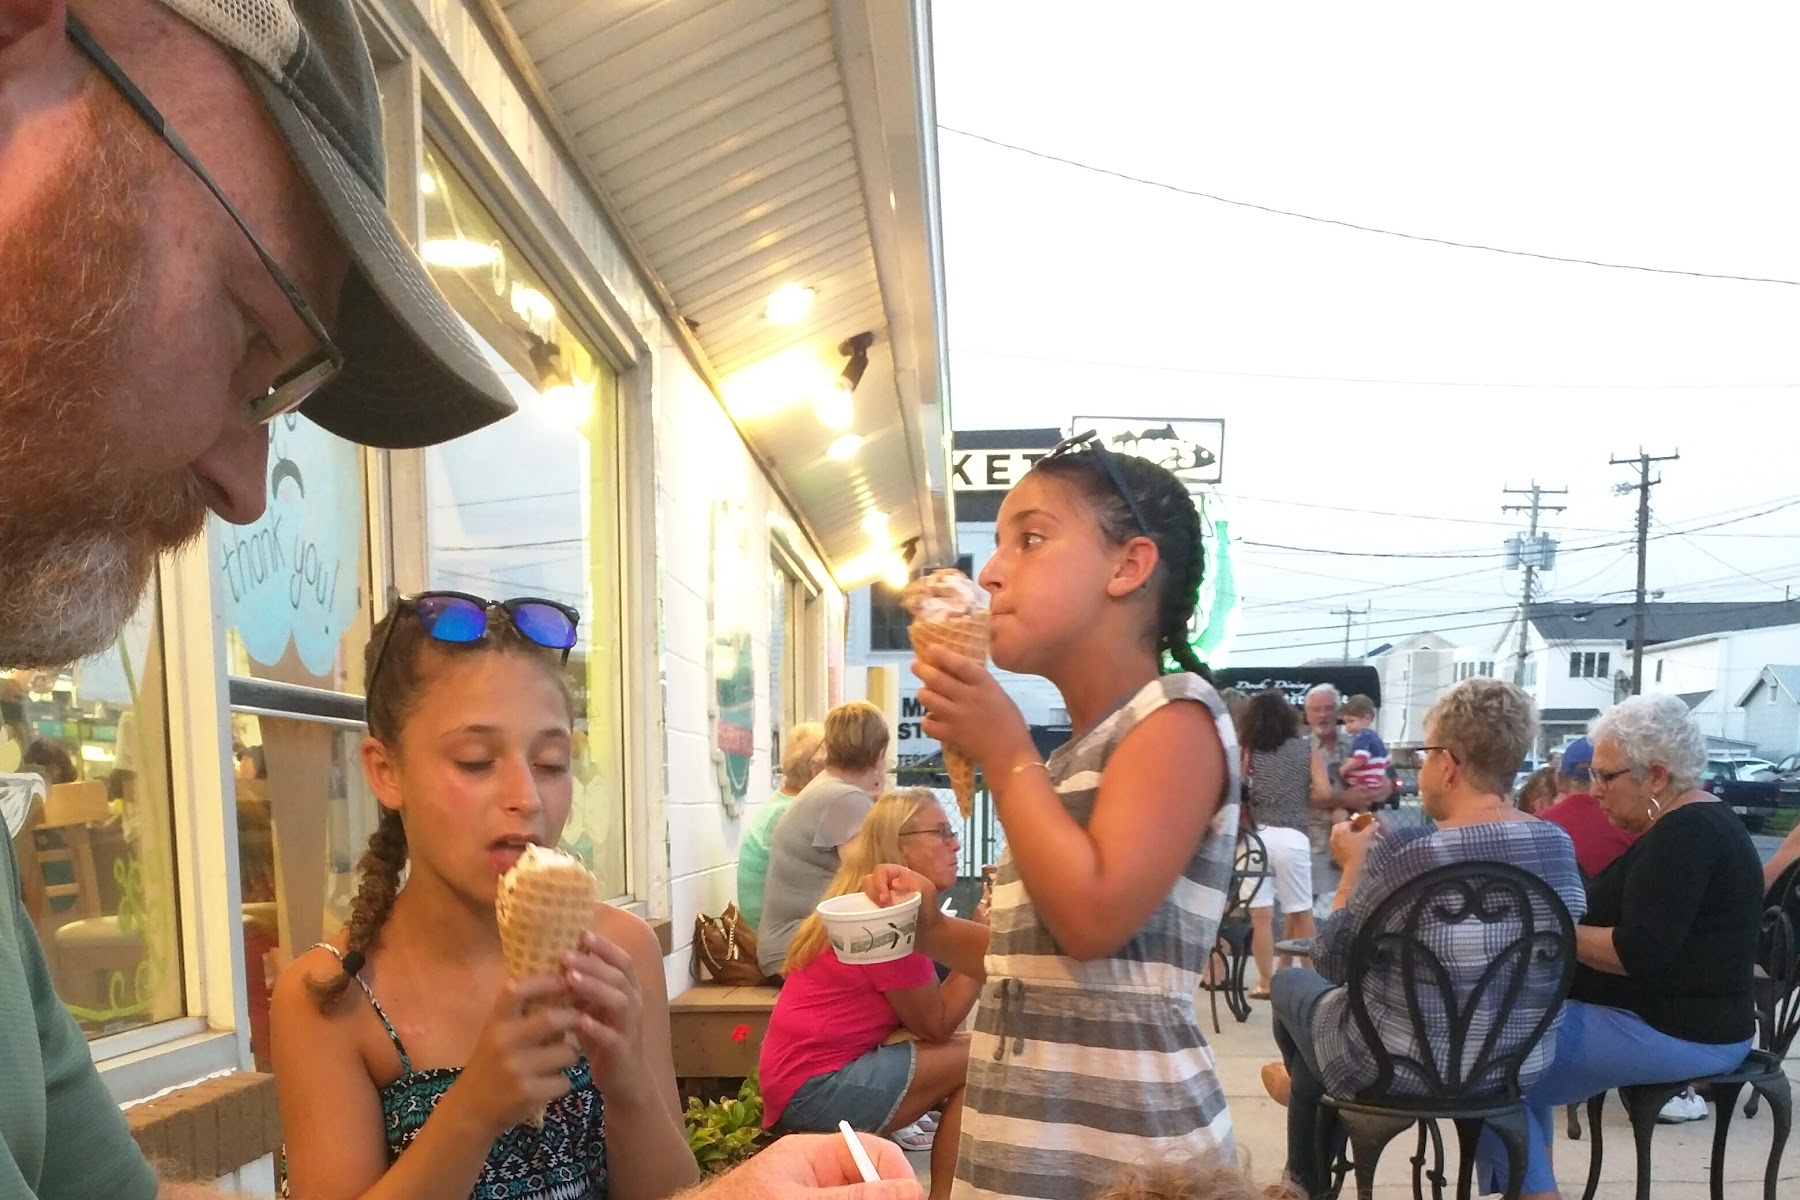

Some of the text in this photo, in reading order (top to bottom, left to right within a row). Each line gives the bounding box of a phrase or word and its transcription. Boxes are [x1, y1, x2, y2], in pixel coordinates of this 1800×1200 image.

[222, 507, 285, 603] thank
[902, 697, 929, 717] M
[897, 722, 928, 740] ST
